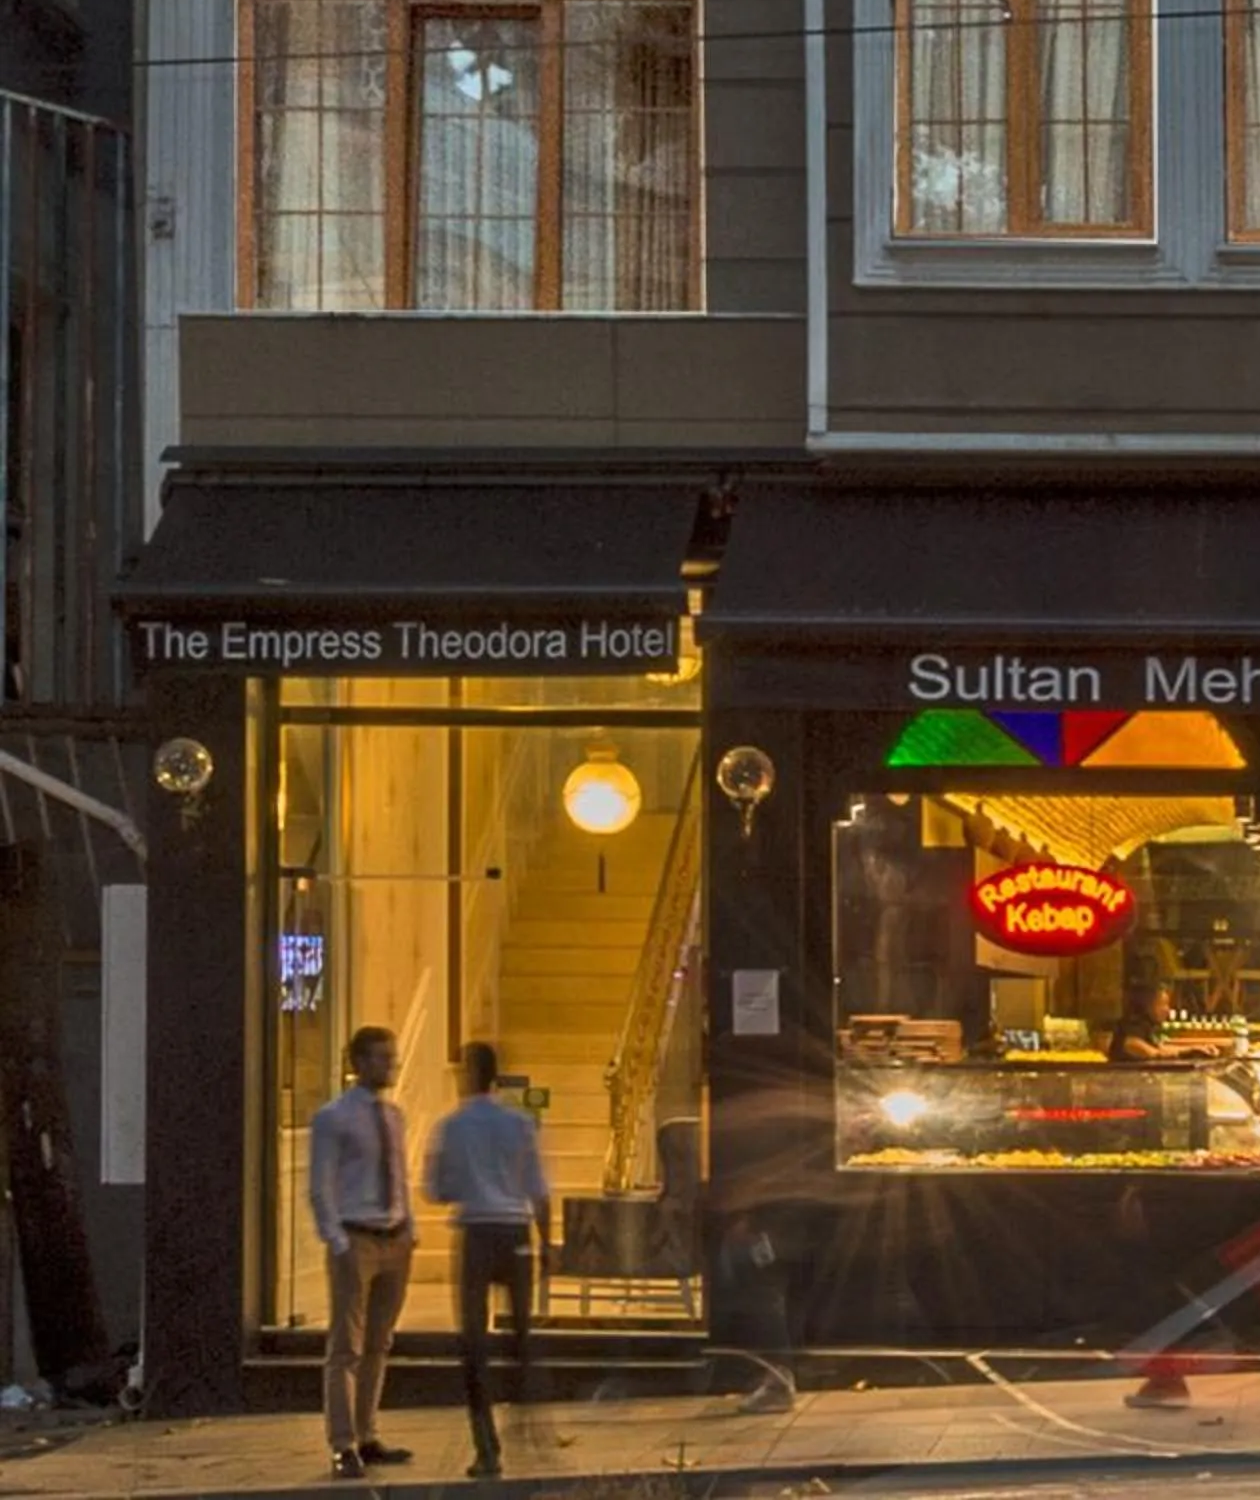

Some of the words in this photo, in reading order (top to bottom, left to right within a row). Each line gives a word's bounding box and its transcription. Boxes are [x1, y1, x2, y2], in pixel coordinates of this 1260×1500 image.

[138, 621, 209, 661] The
[222, 622, 383, 666] Empress
[396, 621, 568, 659] Theodora
[580, 621, 675, 658] Hotel
[908, 654, 1101, 702] Sultan
[977, 865, 1127, 913] Restaurant
[1006, 902, 1095, 937] Kebap
